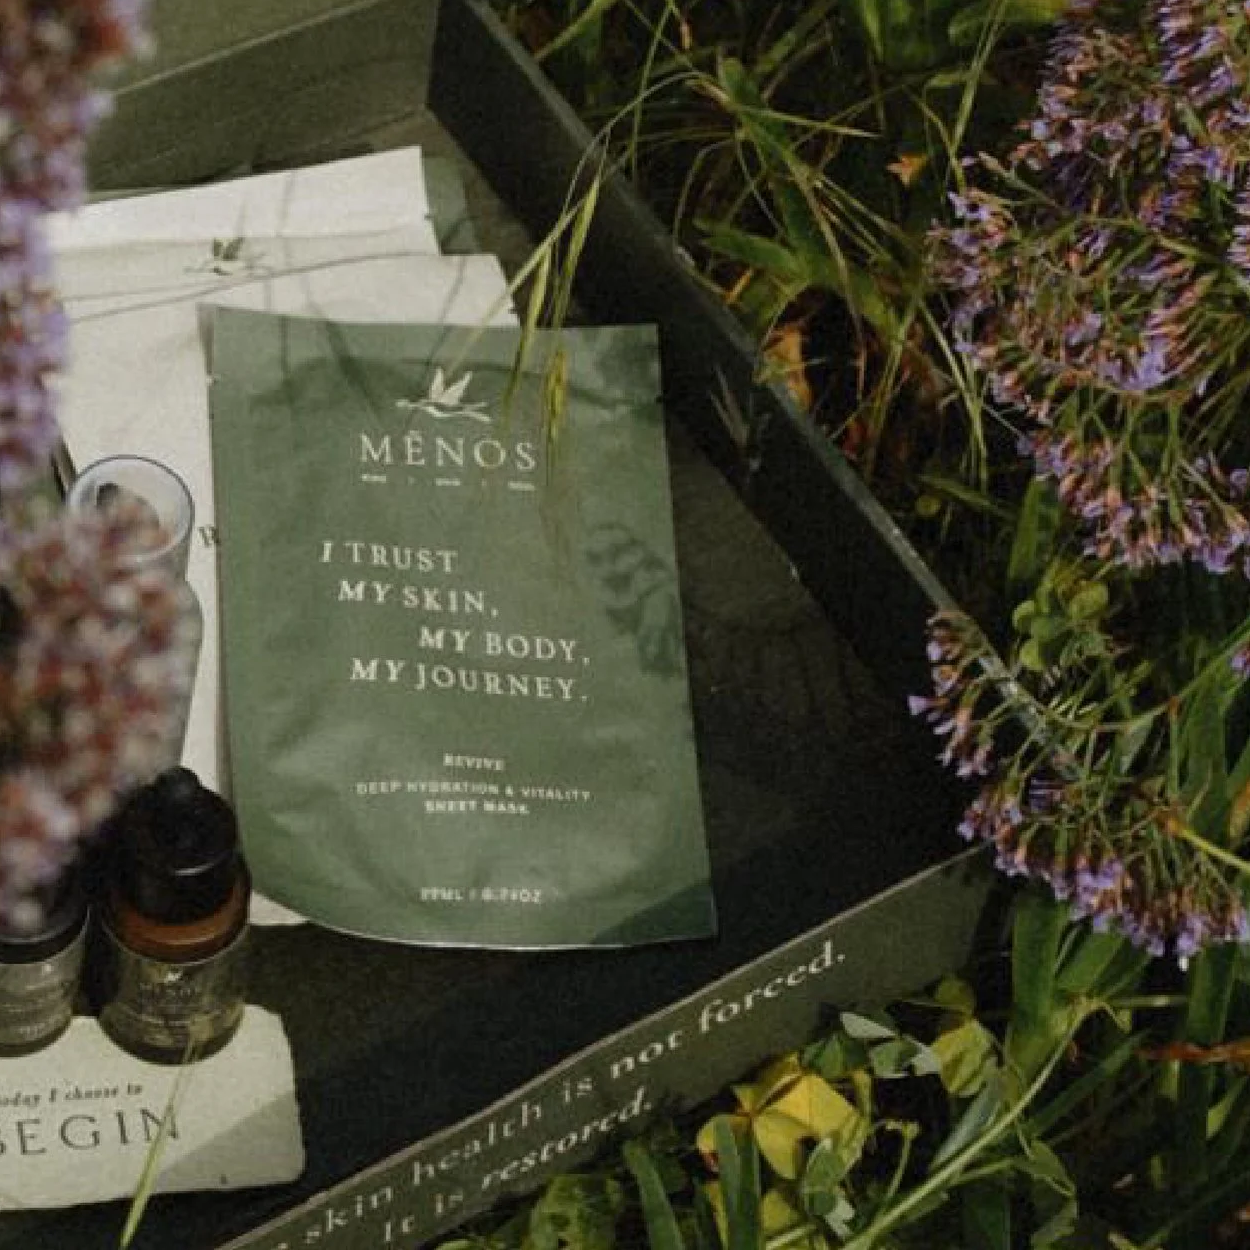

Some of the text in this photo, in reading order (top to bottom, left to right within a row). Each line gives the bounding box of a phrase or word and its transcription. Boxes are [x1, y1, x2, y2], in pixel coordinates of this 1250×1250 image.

[320, 540, 458, 574] I TRUST
[337, 580, 500, 618] MY SKIN,
[418, 626, 591, 666] MY BODY,
[351, 657, 589, 702] MY JOURNEY.
[356, 781, 401, 796] DEEP
[407, 781, 499, 796] HYDRATION
[521, 786, 591, 802] VITALITY
[423, 799, 530, 815] SHEET MASK
[305, 939, 846, 1245] skin health is not forced.
[384, 1085, 652, 1243] It is restored.
